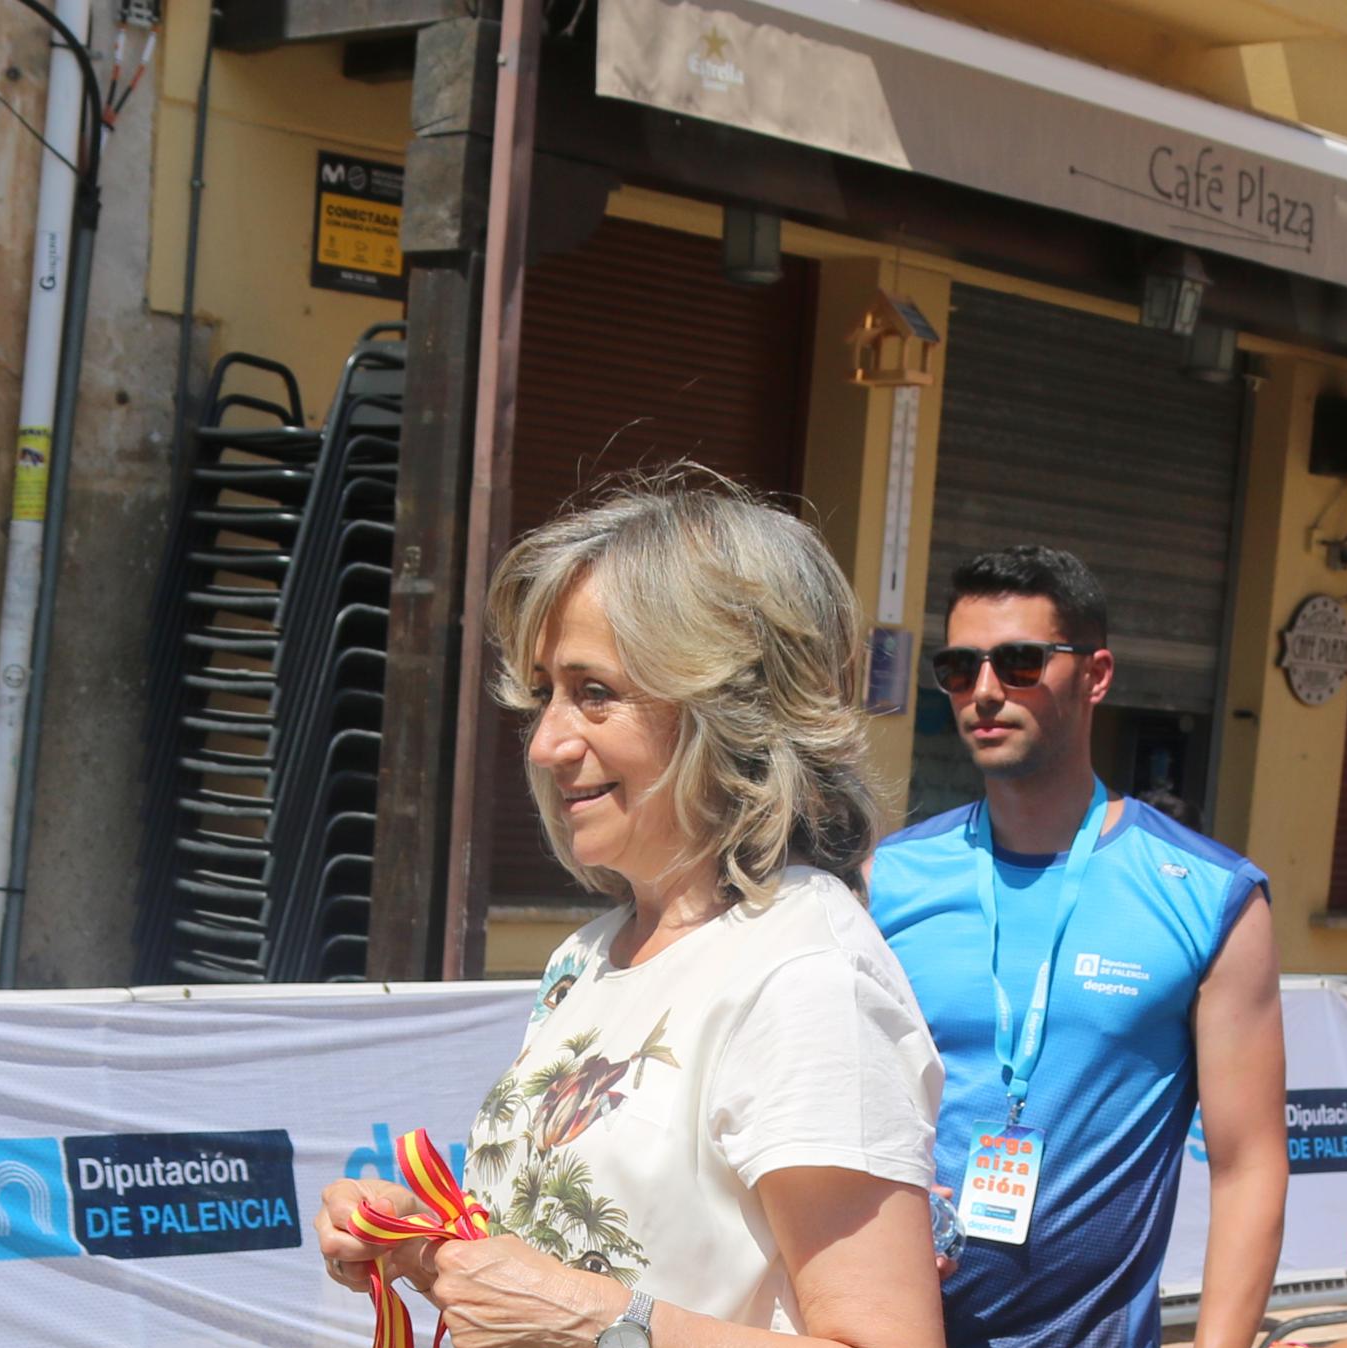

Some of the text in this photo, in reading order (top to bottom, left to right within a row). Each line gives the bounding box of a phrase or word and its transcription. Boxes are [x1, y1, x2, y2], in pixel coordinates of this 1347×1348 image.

[1149, 146, 1314, 244] Café Plaza
[1083, 980, 1139, 996] deportes
[1024, 1011, 1041, 1057] deportes
[979, 1134, 1034, 1156] orga
[1288, 1138, 1312, 1160] DE
[78, 1153, 249, 1196] Diputación
[976, 1154, 1030, 1176] niza
[972, 1175, 1026, 1197] ción
[85, 1198, 293, 1239] DE PALENCIA
